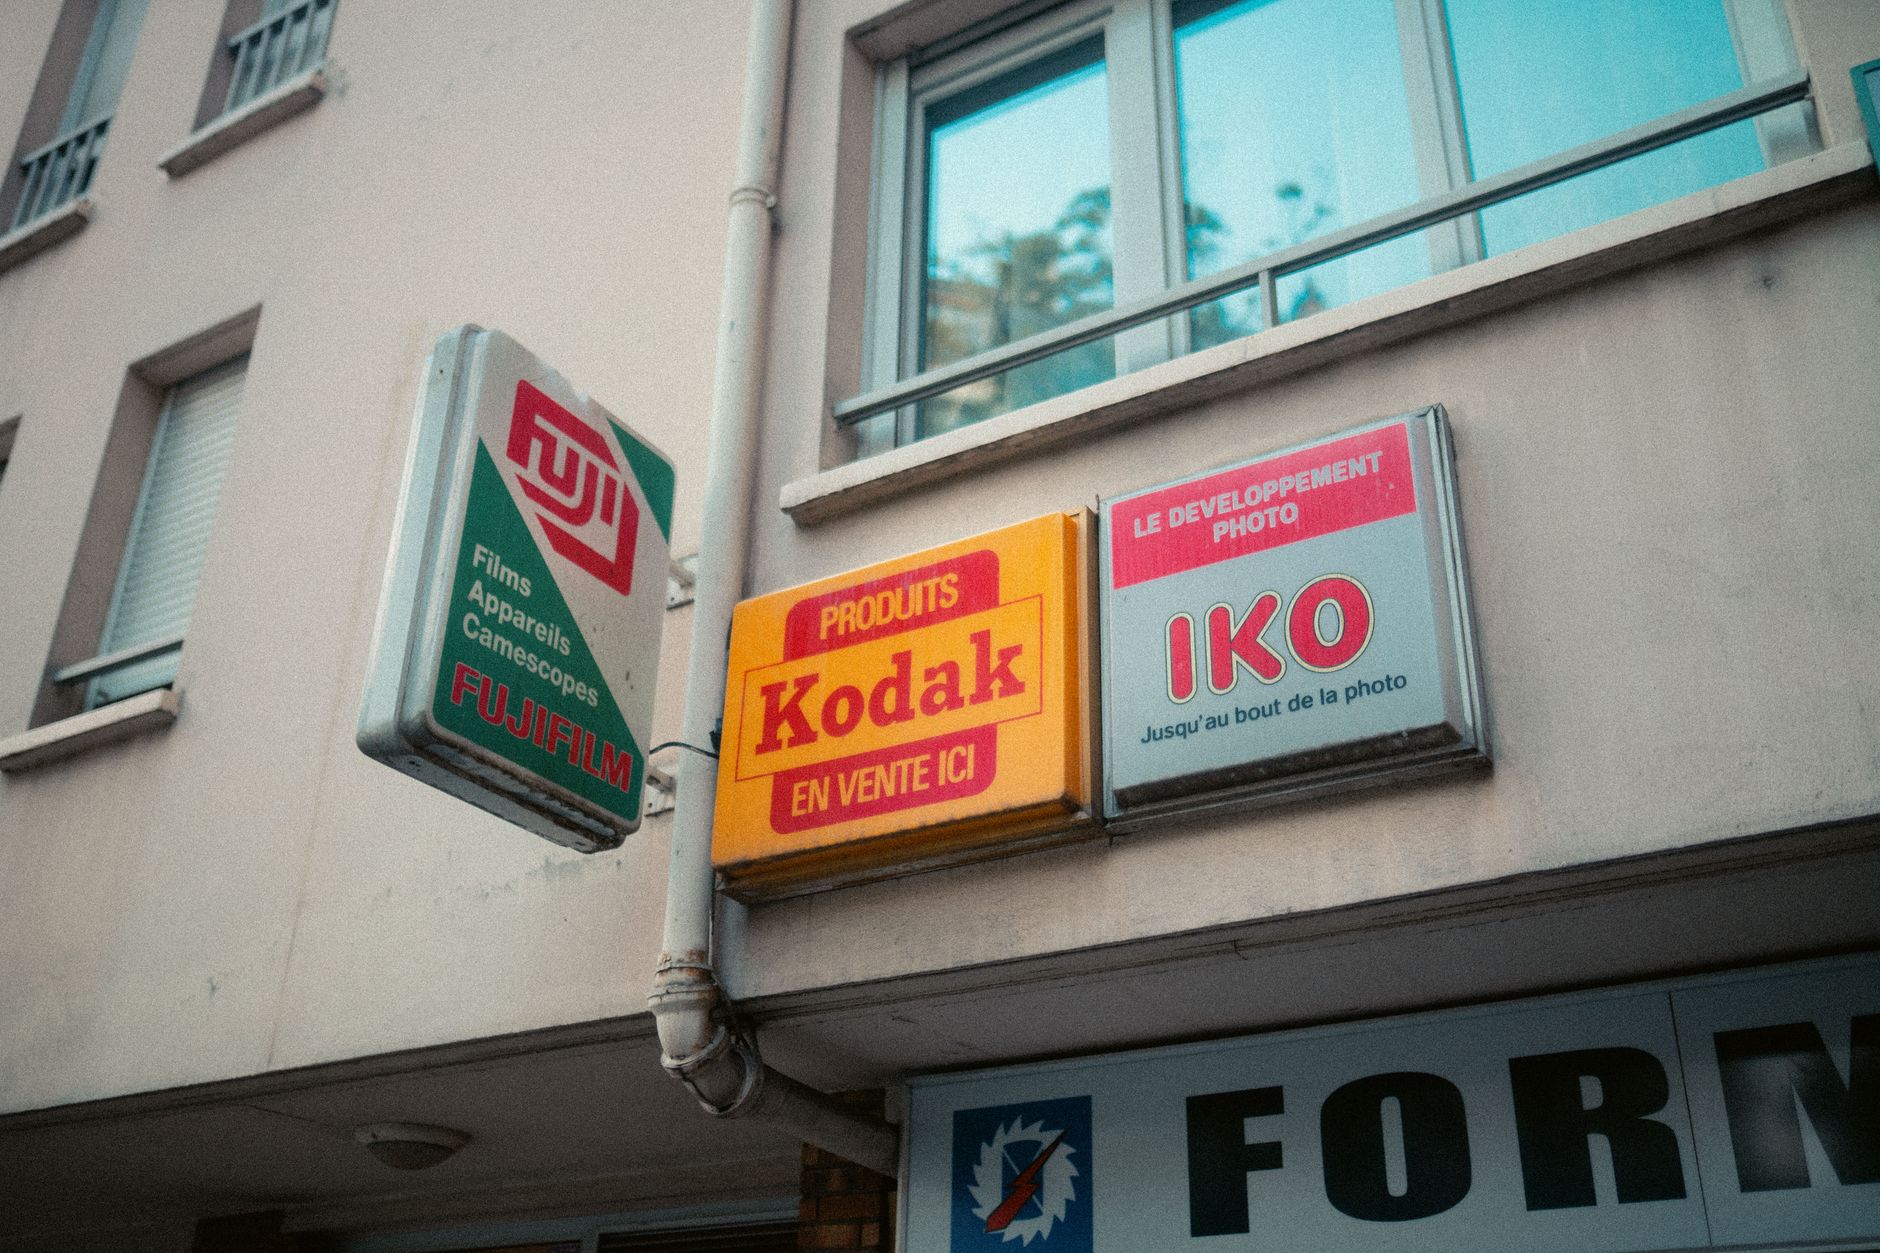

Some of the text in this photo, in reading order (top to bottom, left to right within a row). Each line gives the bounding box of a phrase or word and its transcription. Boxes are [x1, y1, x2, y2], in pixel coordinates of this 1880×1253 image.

[1133, 450, 1383, 537] LE DEVELOPPEMENT
[1213, 501, 1299, 543] PHOTO
[472, 543, 532, 597] Films
[819, 572, 959, 640] PRODUITS
[467, 579, 571, 656] Appareils
[1165, 573, 1375, 705] IKO
[462, 611, 599, 708] Camescopes
[755, 628, 1025, 756] Kodak
[450, 662, 634, 794] FUJIFILM
[1140, 673, 1408, 745] Jusqu'au bout de la photo
[790, 744, 976, 817] EN VENTE ICI
